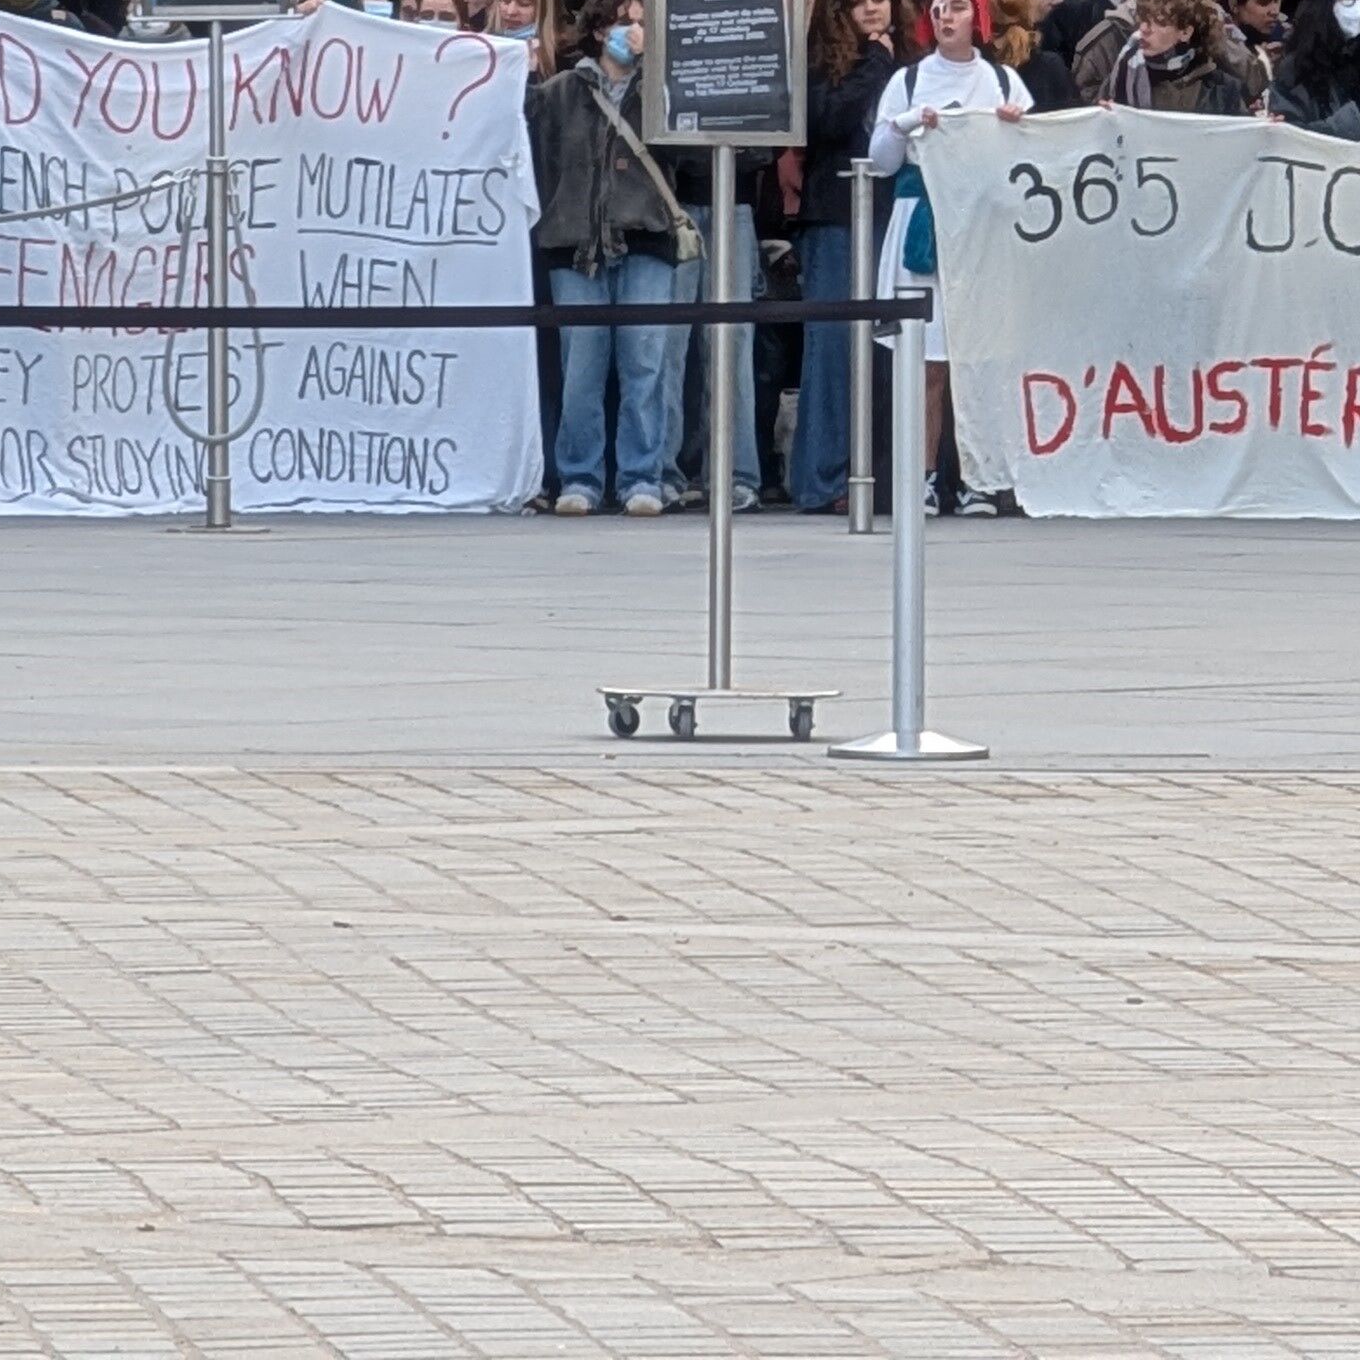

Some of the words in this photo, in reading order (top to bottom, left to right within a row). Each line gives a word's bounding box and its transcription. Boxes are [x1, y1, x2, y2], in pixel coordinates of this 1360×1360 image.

[65, 48, 197, 141] YOU
[229, 39, 404, 131] KNOW
[435, 33, 497, 140] ?
[112, 157, 283, 242] POLCE
[297, 152, 508, 237] MUTILATES
[1008, 153, 1179, 242] 365
[300, 249, 437, 311] WHEN
[298, 341, 458, 408] AGAINST
[248, 427, 457, 496] CONDITIONS
